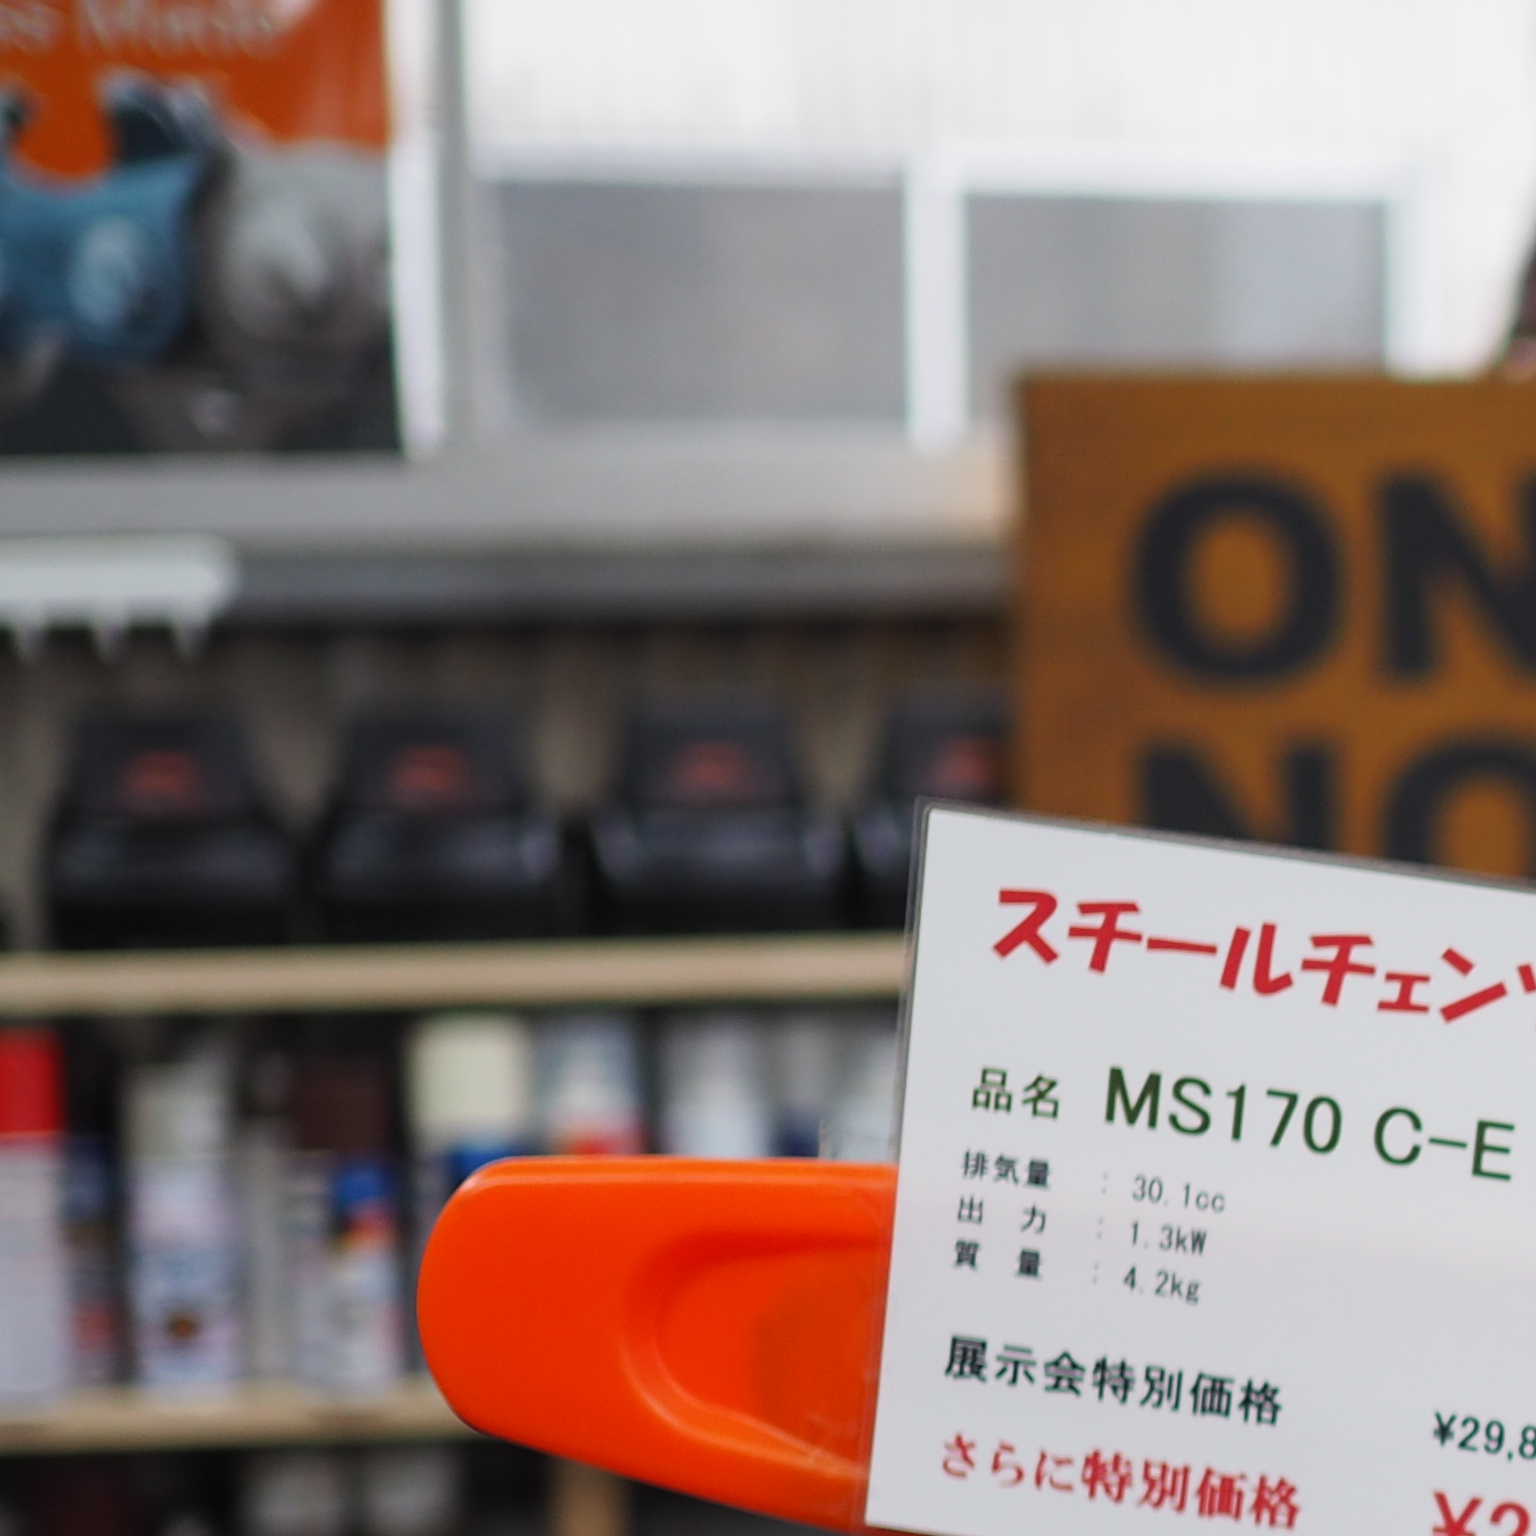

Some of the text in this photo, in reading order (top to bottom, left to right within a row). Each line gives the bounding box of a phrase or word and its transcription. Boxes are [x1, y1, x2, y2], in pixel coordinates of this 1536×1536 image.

[971, 1066, 1060, 1120] 品名
[1104, 1065, 1342, 1154] MS170
[1373, 1106, 1515, 1182] C-E
[962, 1149, 1050, 1189] 排気量
[1132, 1174, 1226, 1213] 30.1cc
[1131, 1220, 1207, 1256] 1.3kW
[1123, 1265, 1201, 1306] 4.2kg
[945, 1334, 1283, 1427] 展示会特別価格
[942, 1431, 1302, 1530] さらに特別価格
